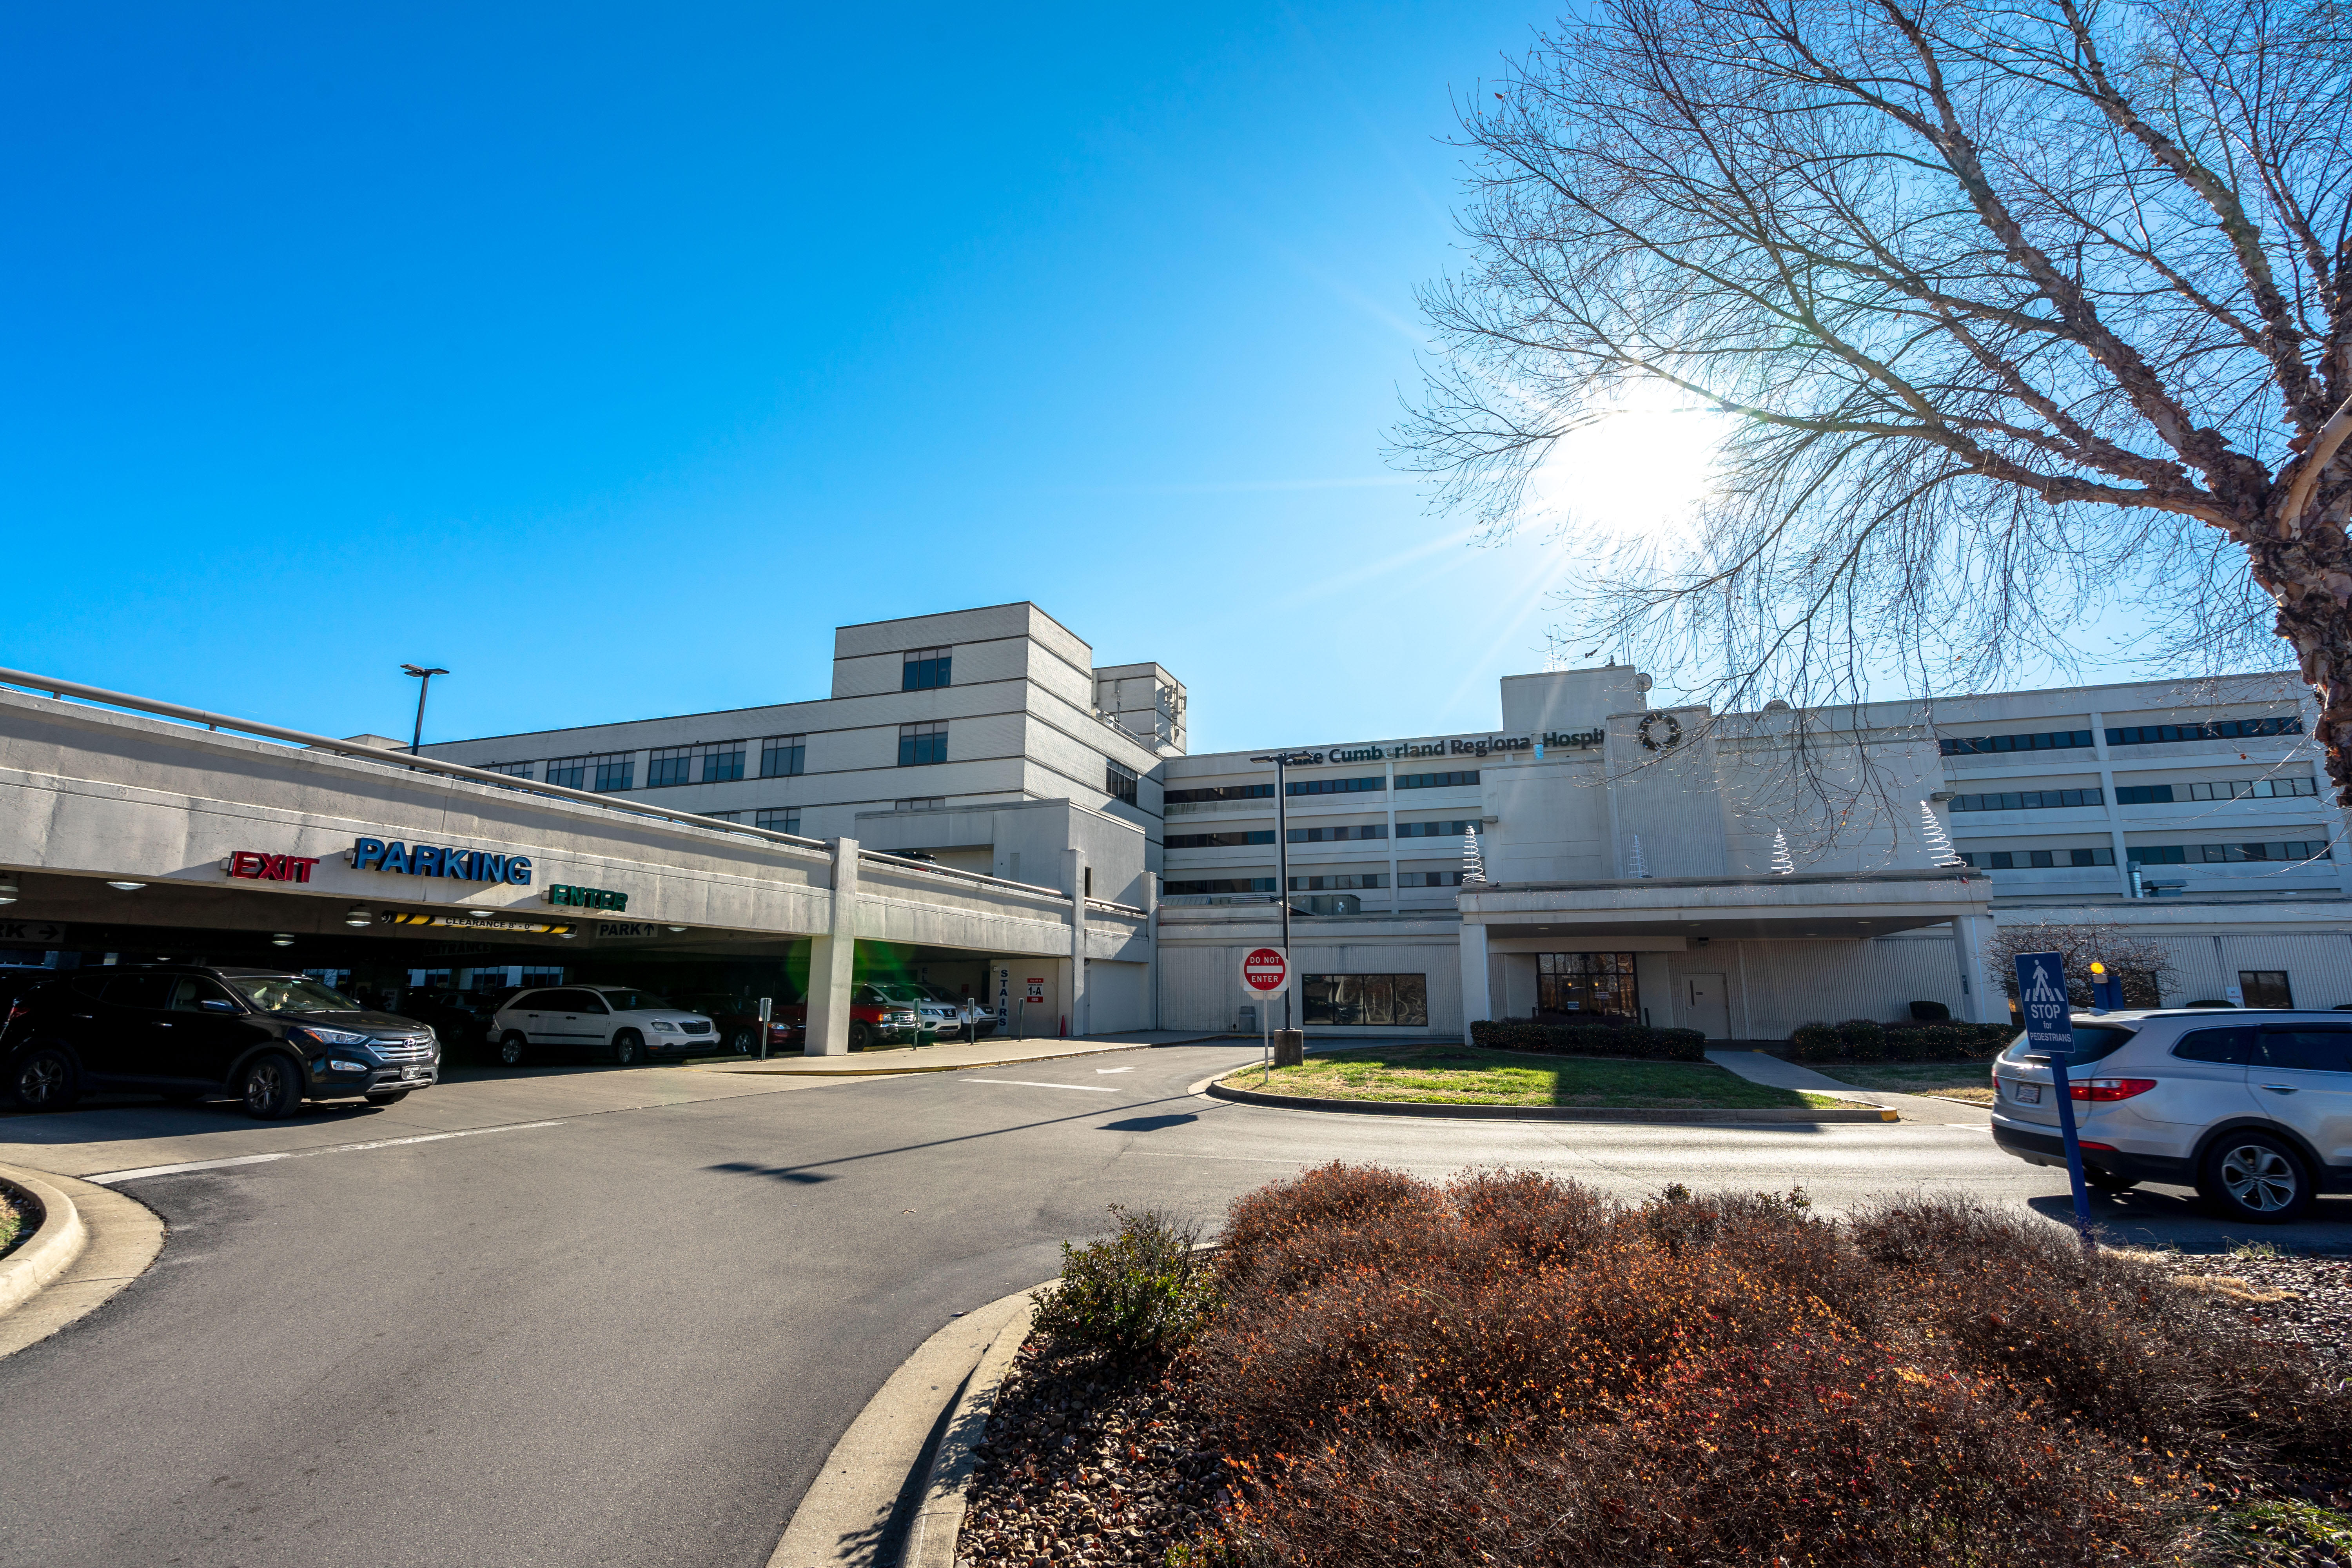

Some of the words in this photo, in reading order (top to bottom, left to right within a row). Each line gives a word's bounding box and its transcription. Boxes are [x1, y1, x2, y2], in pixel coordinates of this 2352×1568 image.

[1329, 740, 1445, 763] Cumberland
[1450, 733, 1535, 757] Regiona
[227, 851, 320, 883] EXIT
[352, 838, 532, 885] PARKING
[548, 884, 628, 912] ENTER
[446, 918, 506, 928] CLEARANCE
[600, 923, 641, 936] PARK
[999, 969, 1008, 1026] STAIRS
[1028, 986, 1042, 995] 1-A
[2031, 1004, 2060, 1019] STOP
[2030, 1032, 2071, 1042] PEDESTRIANS
